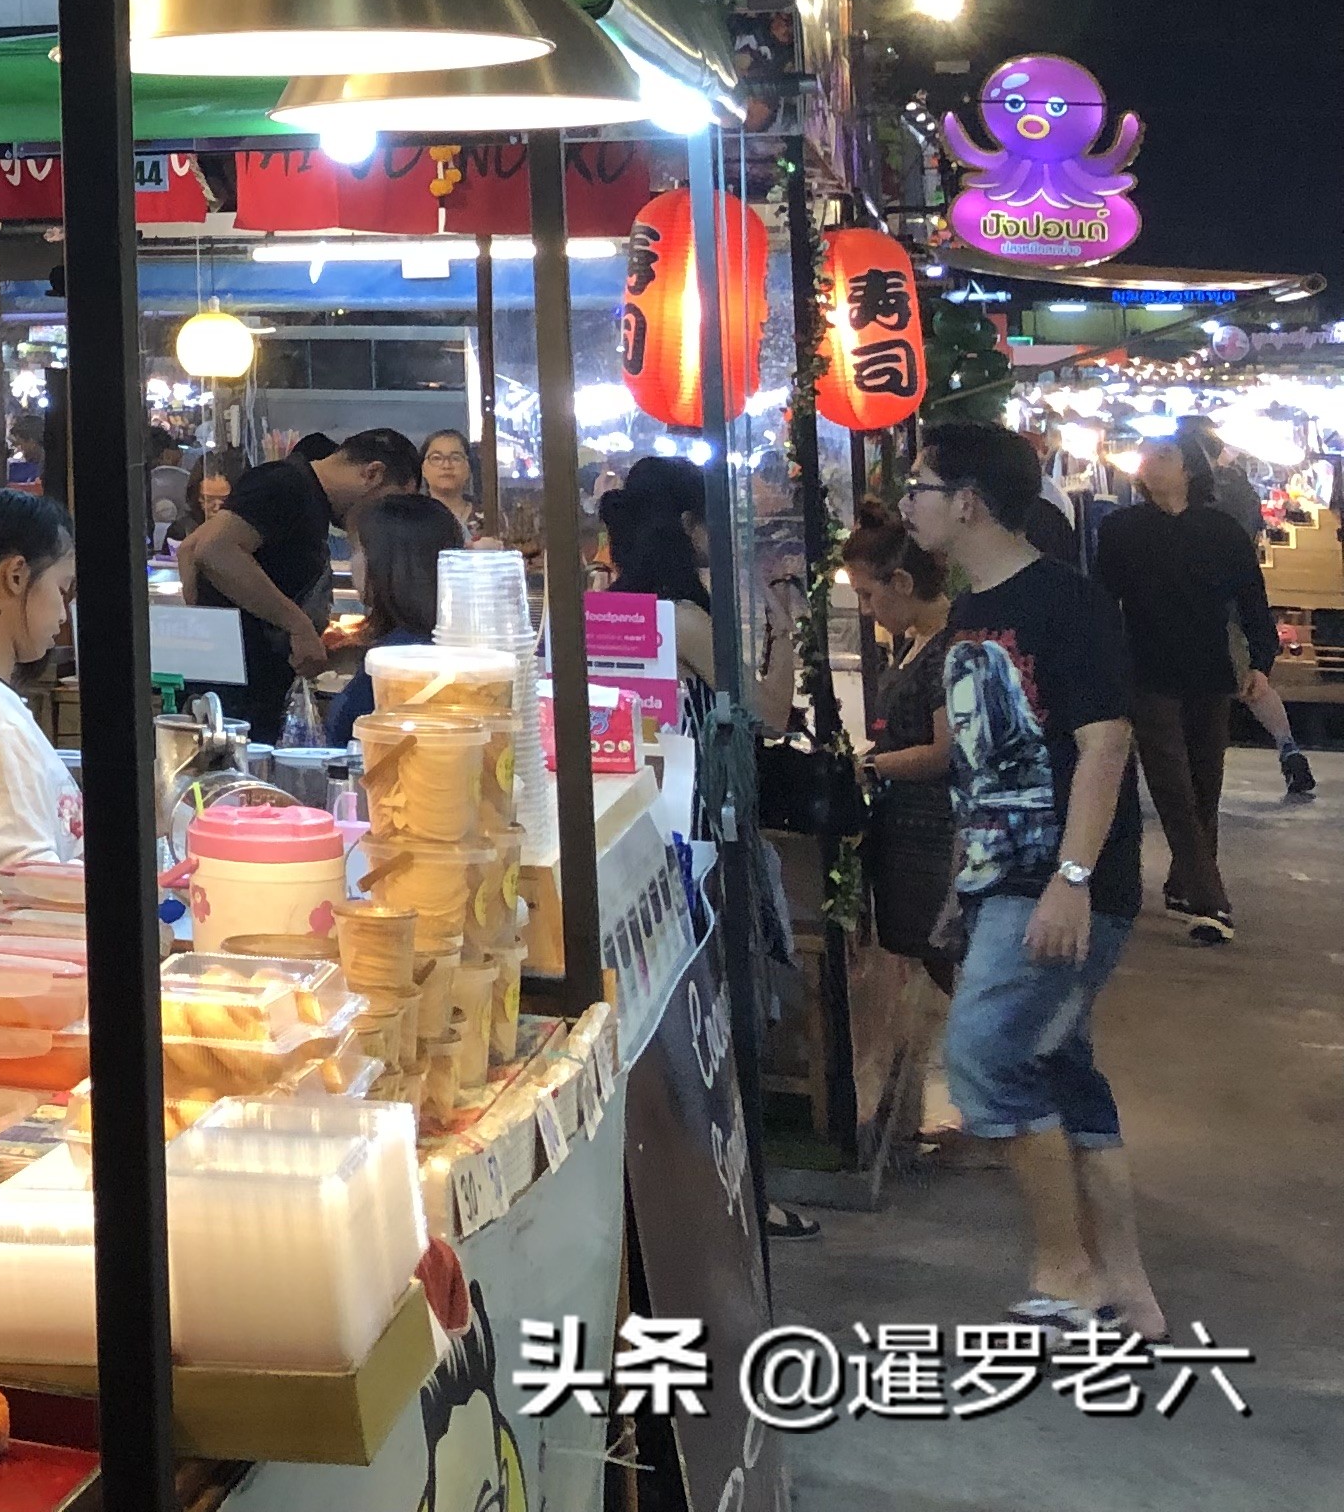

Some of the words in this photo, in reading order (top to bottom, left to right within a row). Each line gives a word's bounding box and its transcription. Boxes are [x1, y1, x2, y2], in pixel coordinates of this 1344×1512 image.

[981, 209, 1111, 242] ปังปอนด์
[841, 269, 918, 397] 寿司
